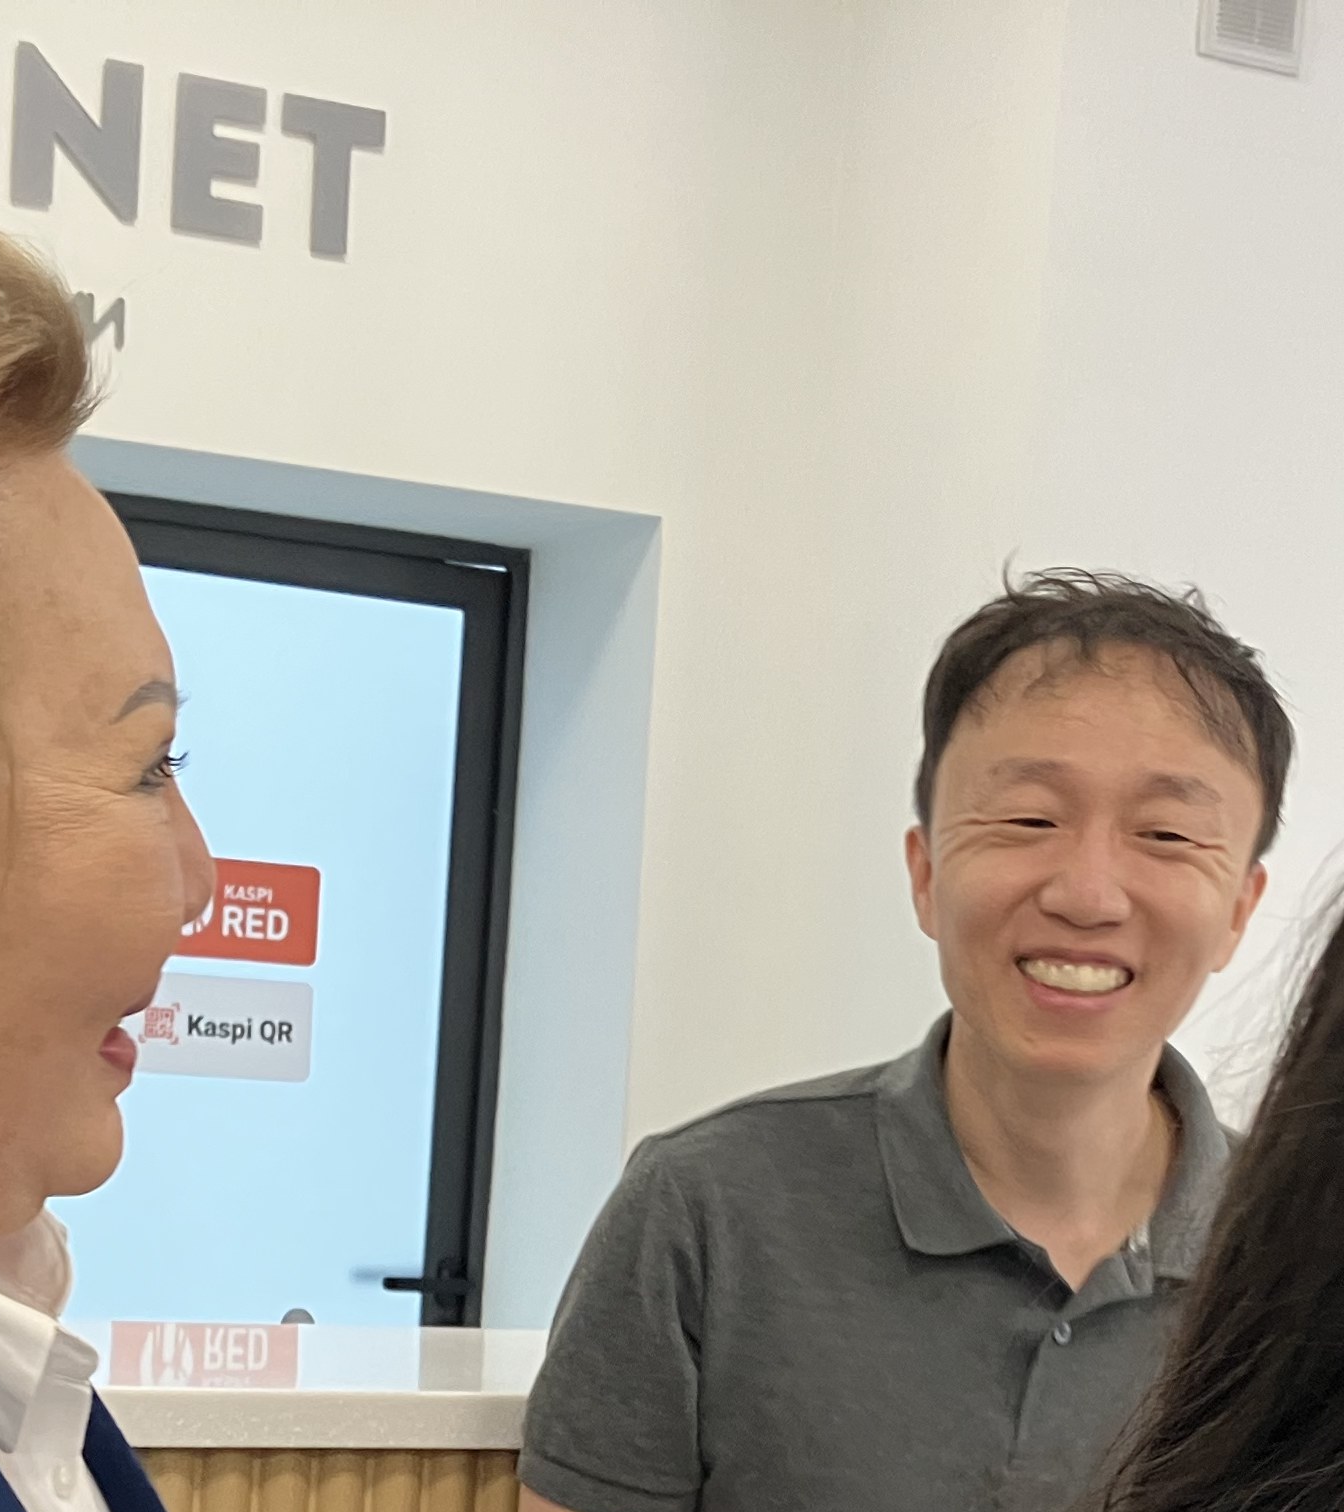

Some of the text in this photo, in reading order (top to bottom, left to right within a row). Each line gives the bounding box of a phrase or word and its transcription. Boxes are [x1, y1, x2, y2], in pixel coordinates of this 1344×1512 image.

[223, 884, 273, 904] KASPI
[221, 904, 289, 941] RED
[187, 1014, 294, 1045] Kaspi QR
